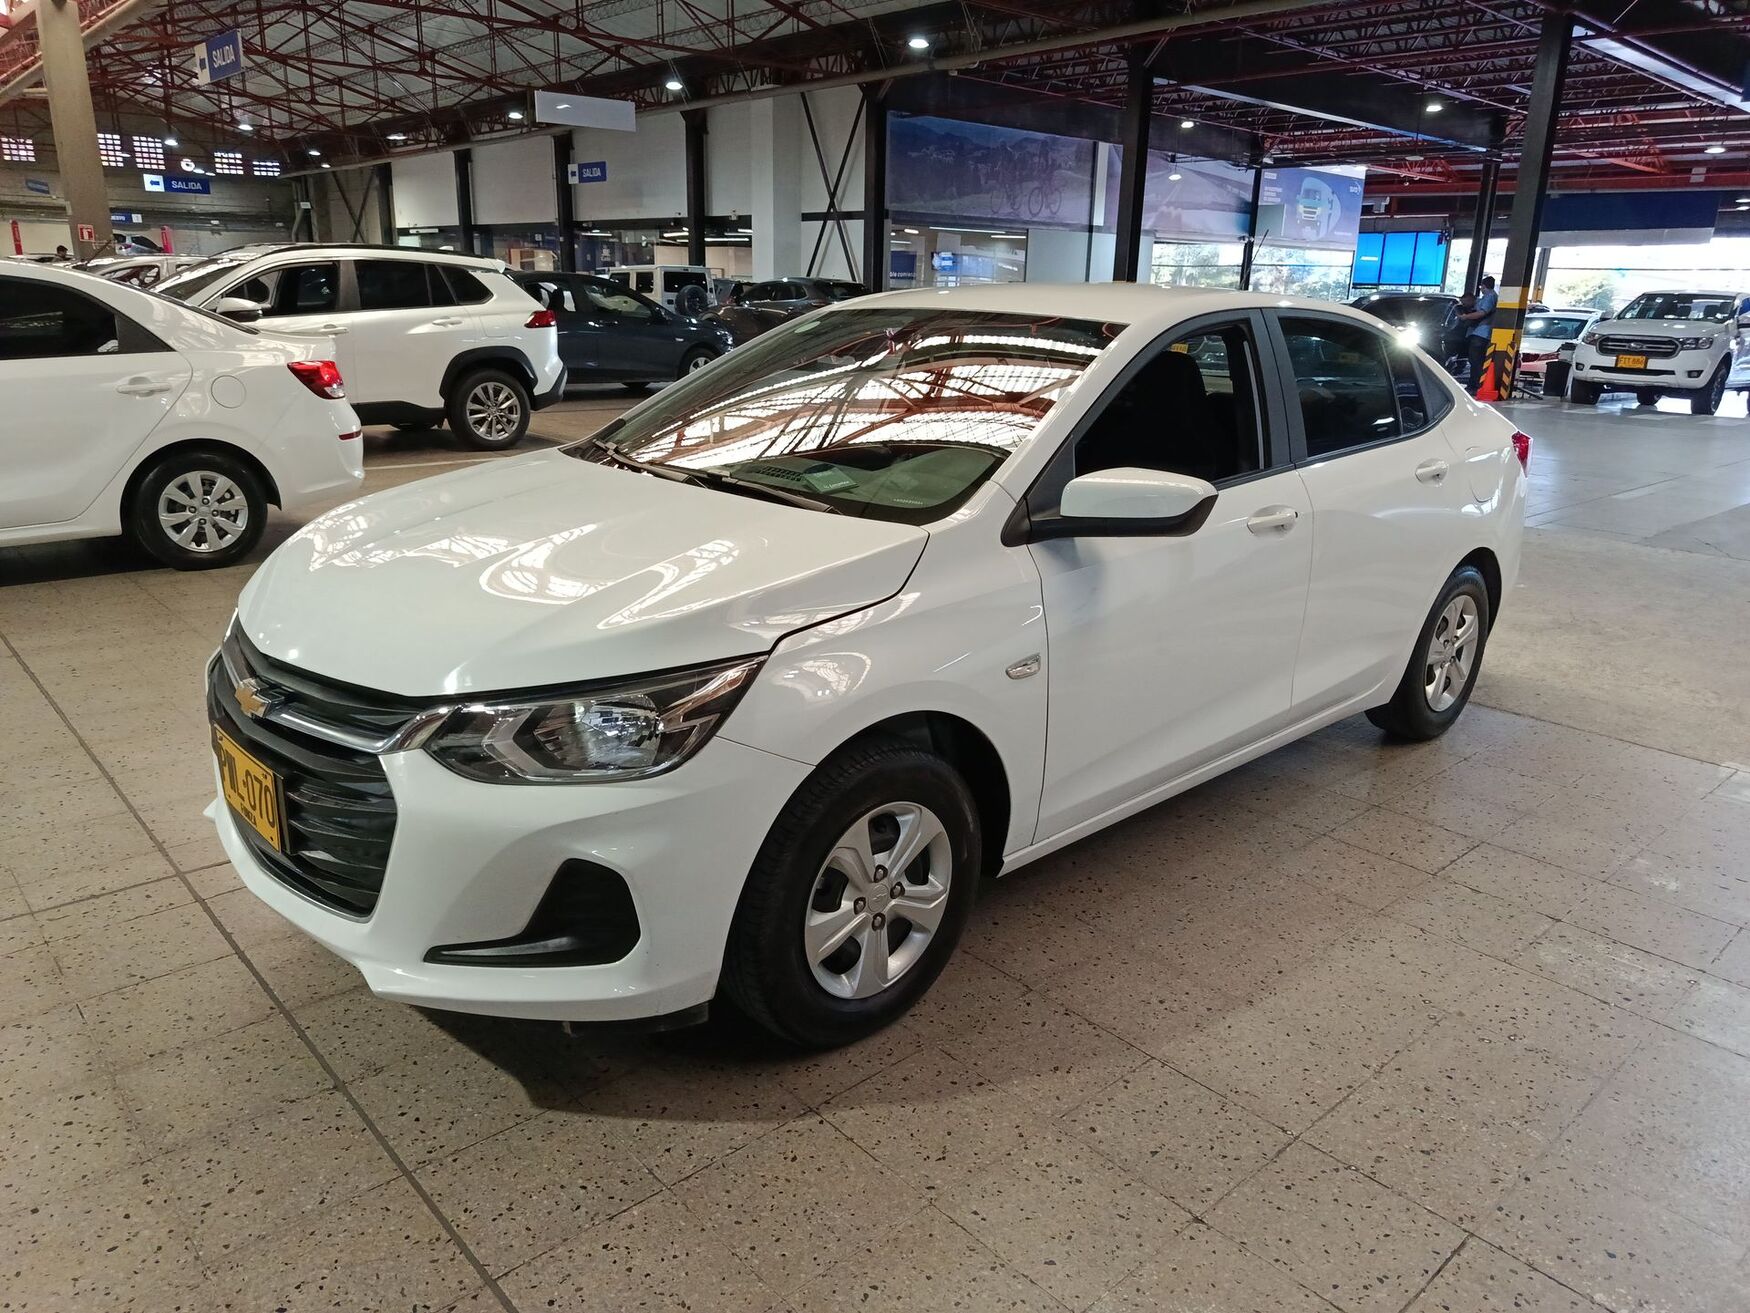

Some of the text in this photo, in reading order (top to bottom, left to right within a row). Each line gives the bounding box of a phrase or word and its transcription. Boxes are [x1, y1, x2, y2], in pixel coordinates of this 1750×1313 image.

[212, 44, 235, 68] SALIDA
[582, 168, 601, 177] SALIDA
[171, 180, 202, 190] SALIDA
